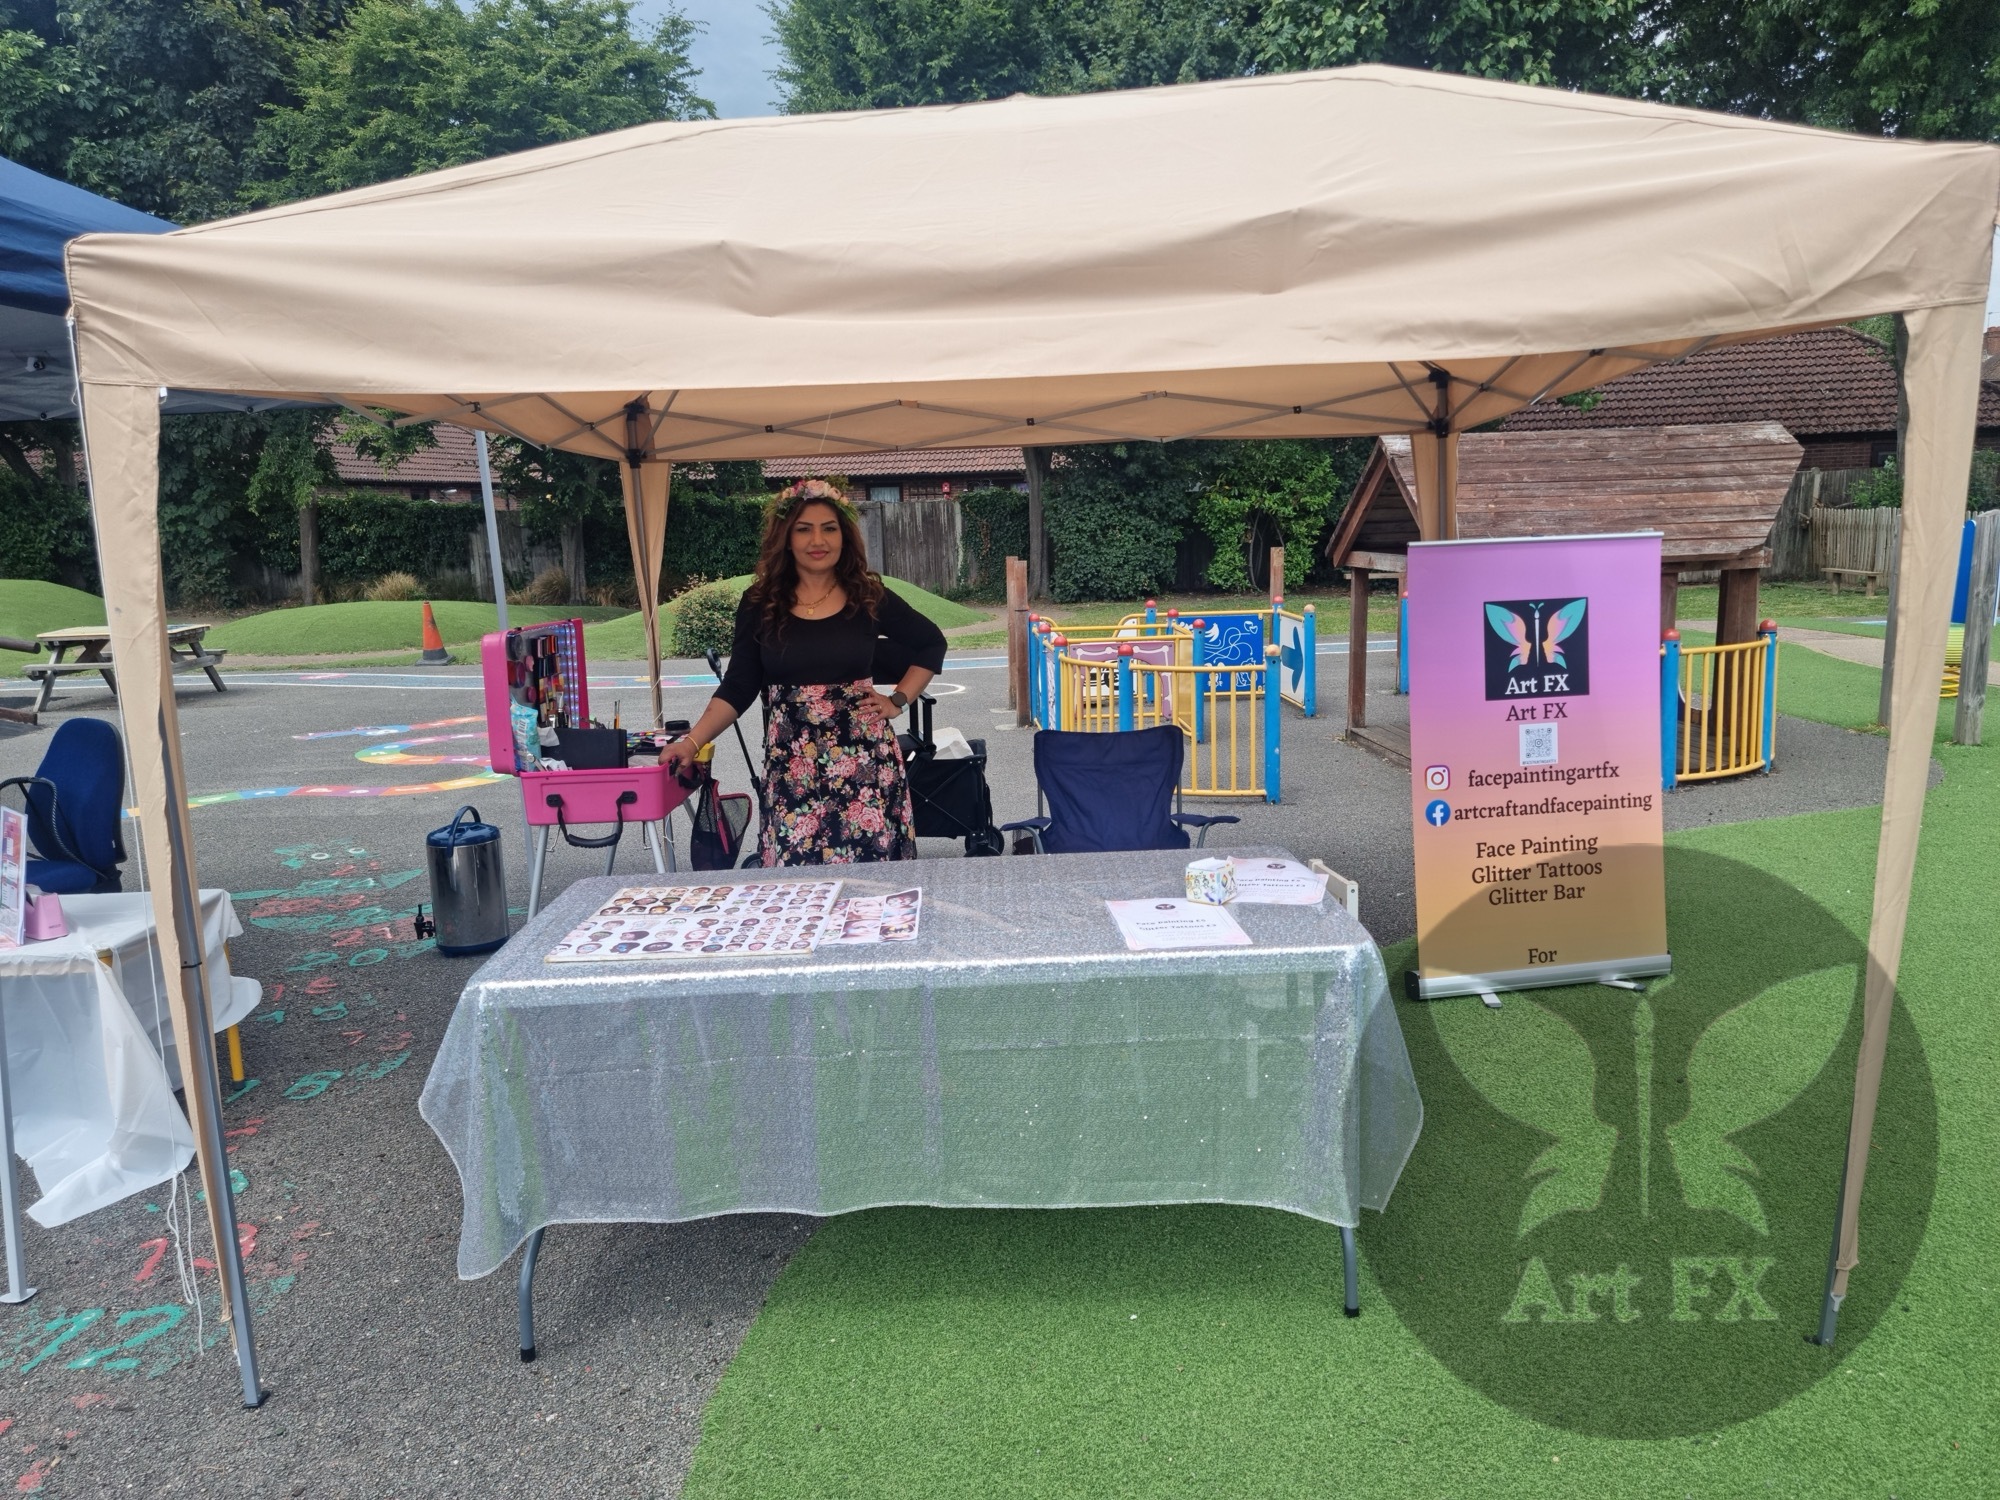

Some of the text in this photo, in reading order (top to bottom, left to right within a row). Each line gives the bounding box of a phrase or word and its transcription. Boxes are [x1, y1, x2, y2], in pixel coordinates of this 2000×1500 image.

[1504, 673, 1570, 695] Art FX
[1505, 702, 1568, 722] Art FX
[1468, 762, 1620, 789] facepaintingartfx
[1454, 794, 1653, 821] artcraftandfacepainting
[1476, 834, 1598, 858] Face Painting
[1472, 861, 1603, 884] Glitter Tattoos
[1488, 884, 1586, 906] Glitter Bar
[286, 948, 389, 973] 20
[1528, 948, 1557, 965] For
